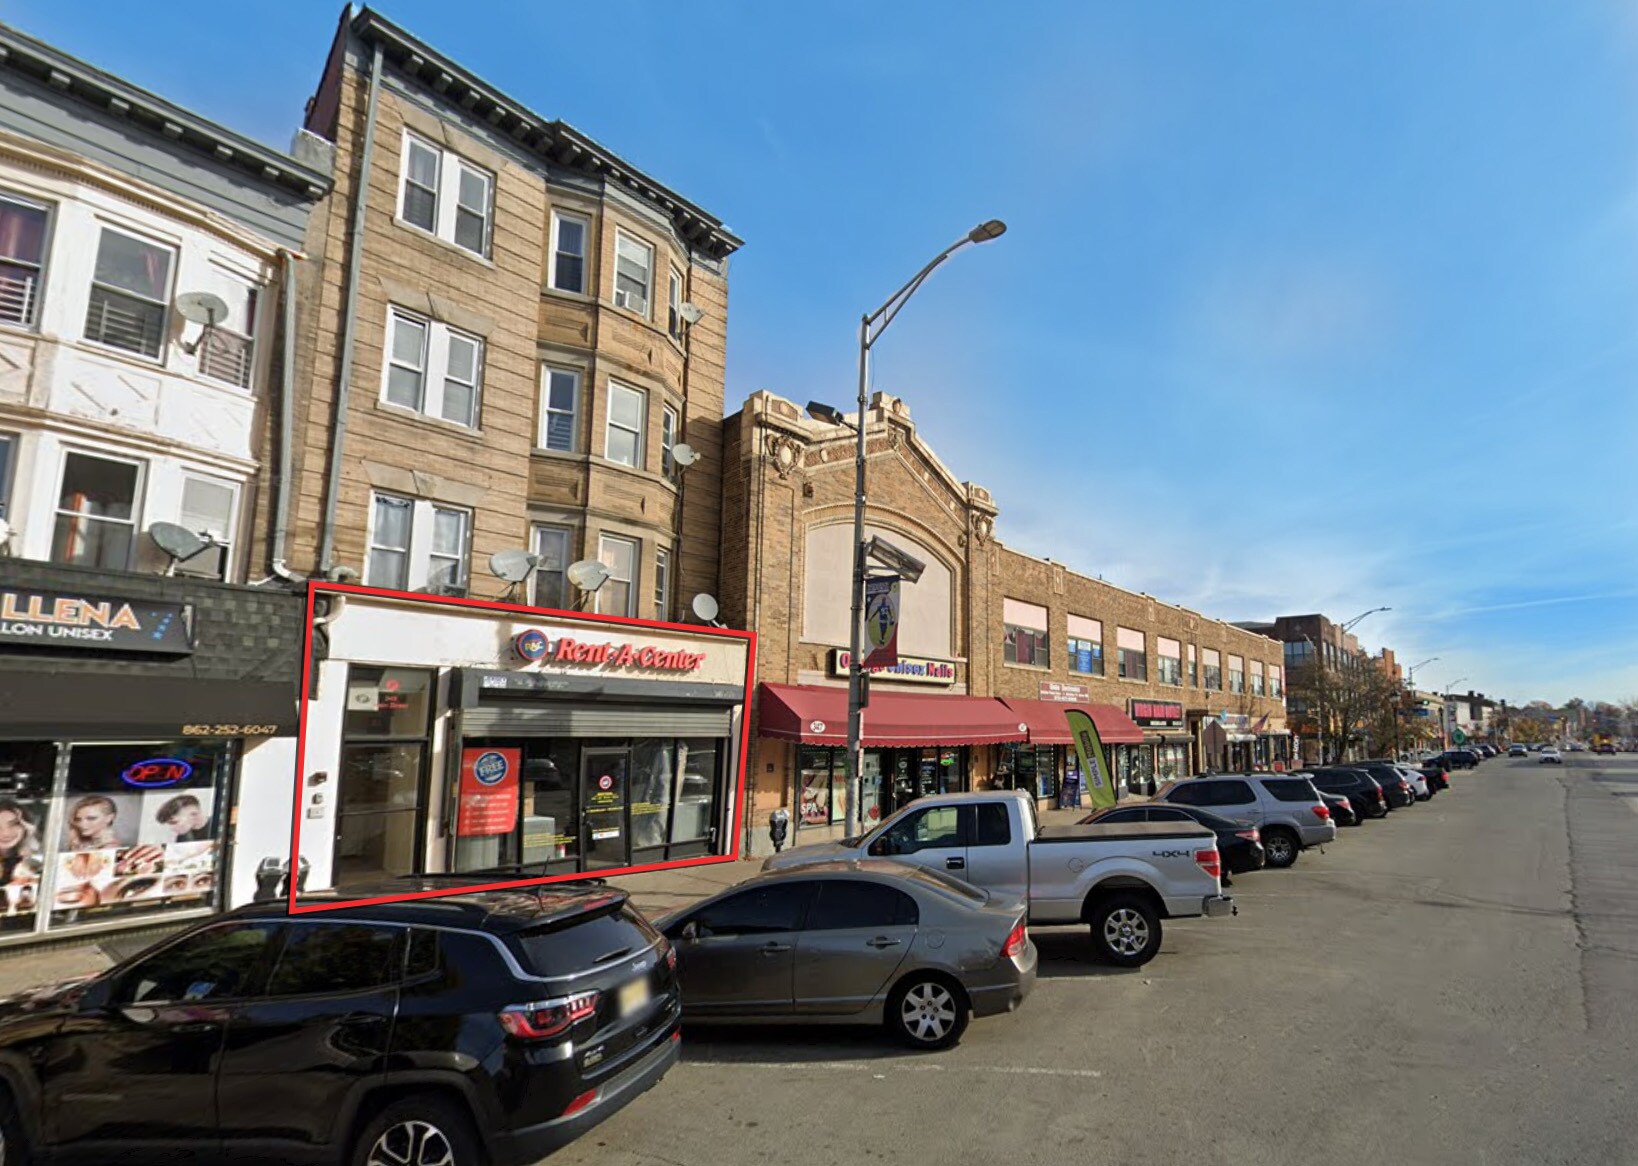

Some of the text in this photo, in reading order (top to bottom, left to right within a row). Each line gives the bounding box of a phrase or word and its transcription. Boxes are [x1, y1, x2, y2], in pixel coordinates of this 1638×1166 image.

[2, 593, 141, 629] LLENA
[1, 622, 114, 640] LON UNISEX
[925, 662, 954, 678] Nails
[182, 725, 278, 735] 862-252-6047
[128, 765, 185, 780] OPN
[801, 803, 818, 814] SPA
